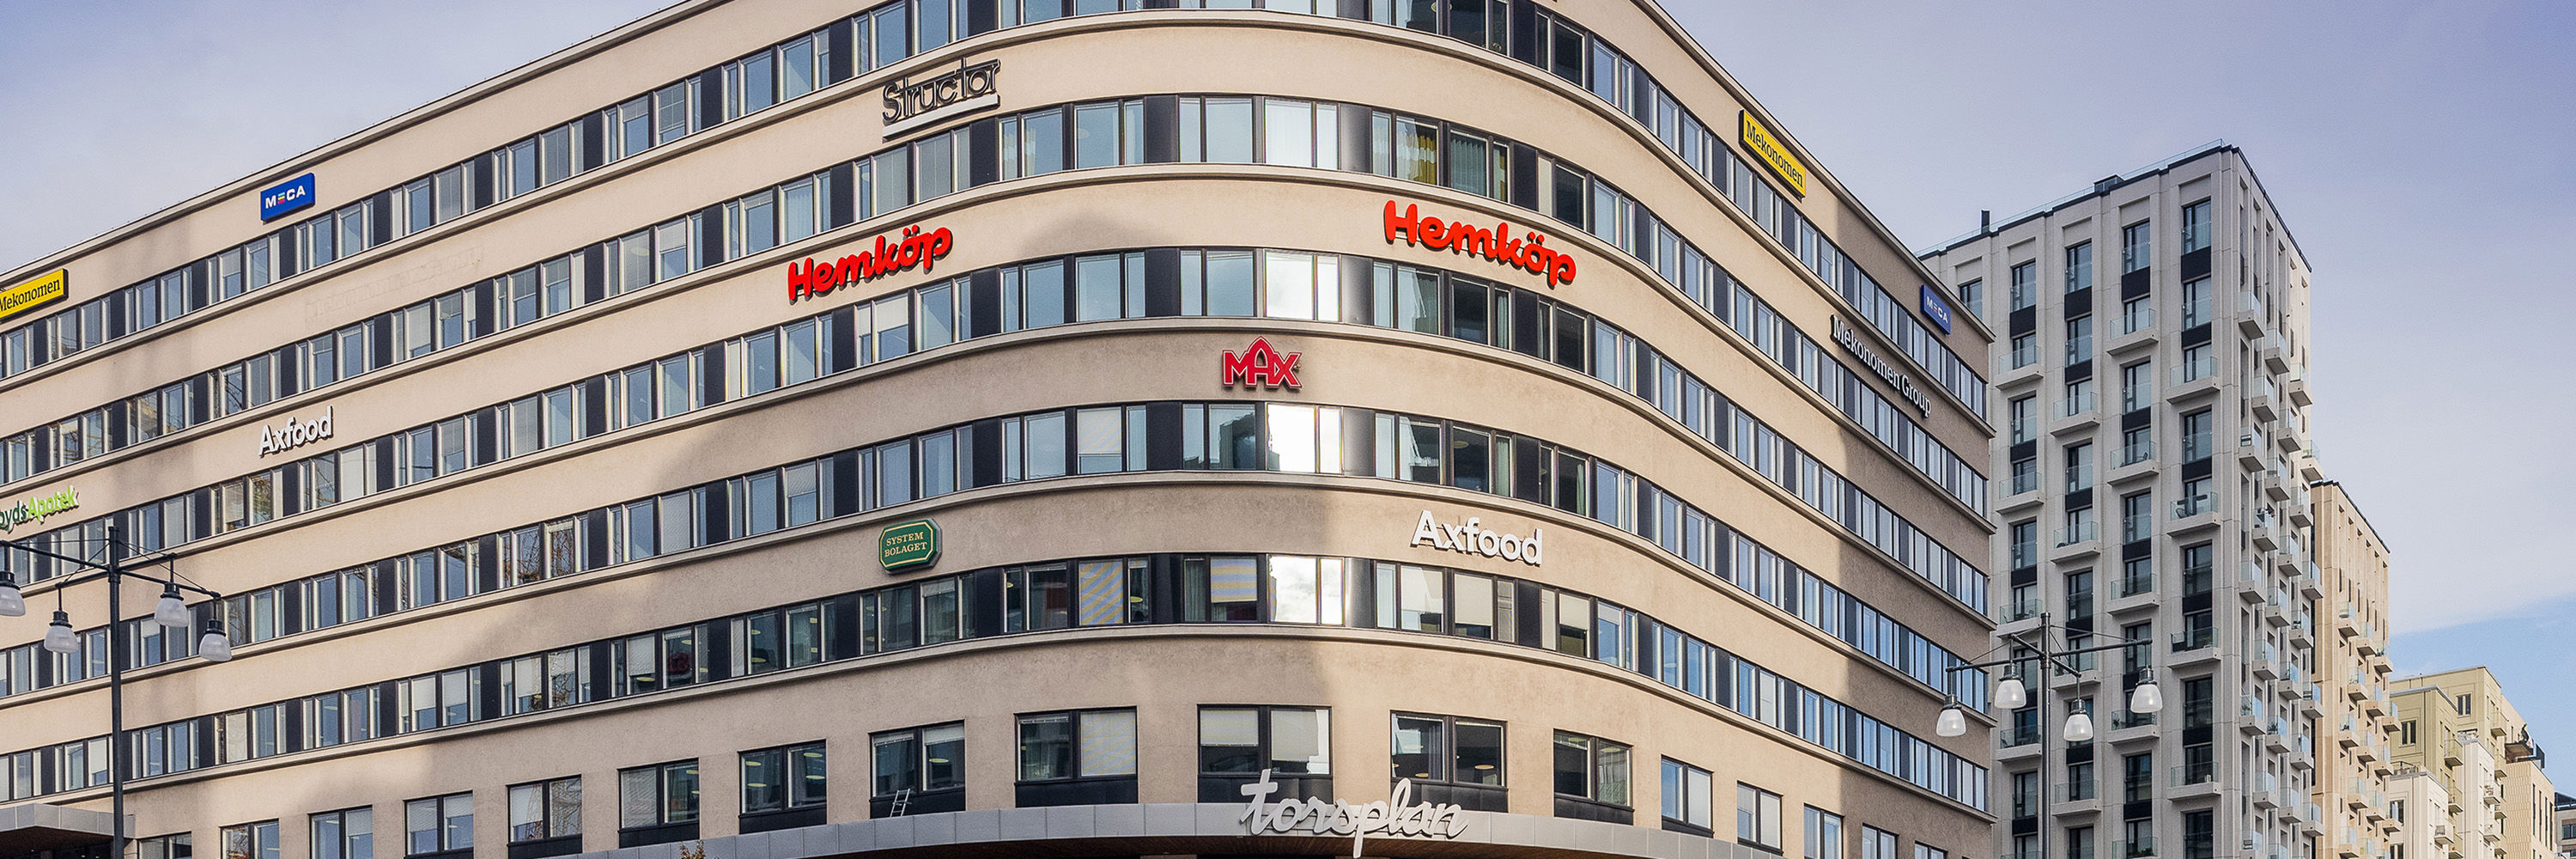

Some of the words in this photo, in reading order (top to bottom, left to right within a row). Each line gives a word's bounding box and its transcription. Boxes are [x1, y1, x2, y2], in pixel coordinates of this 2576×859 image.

[883, 58, 1000, 125] Structor
[1746, 119, 1803, 188] Mekonomen
[264, 185, 306, 209] MECA
[787, 225, 953, 304] Hemköp
[1385, 200, 1577, 288] Hemköp
[0, 278, 61, 313] Mekonomen
[1926, 295, 1948, 324] MECA
[1222, 336, 1303, 389] MAX
[1832, 314, 1900, 390] Mekonomen
[1901, 374, 1932, 418] Group
[259, 407, 333, 455] Axfood
[884, 541, 928, 557] BOLAGET
[885, 531, 924, 547] SYSTEM
[1410, 510, 1544, 566] Axfood
[1240, 769, 1468, 858] torsplan
